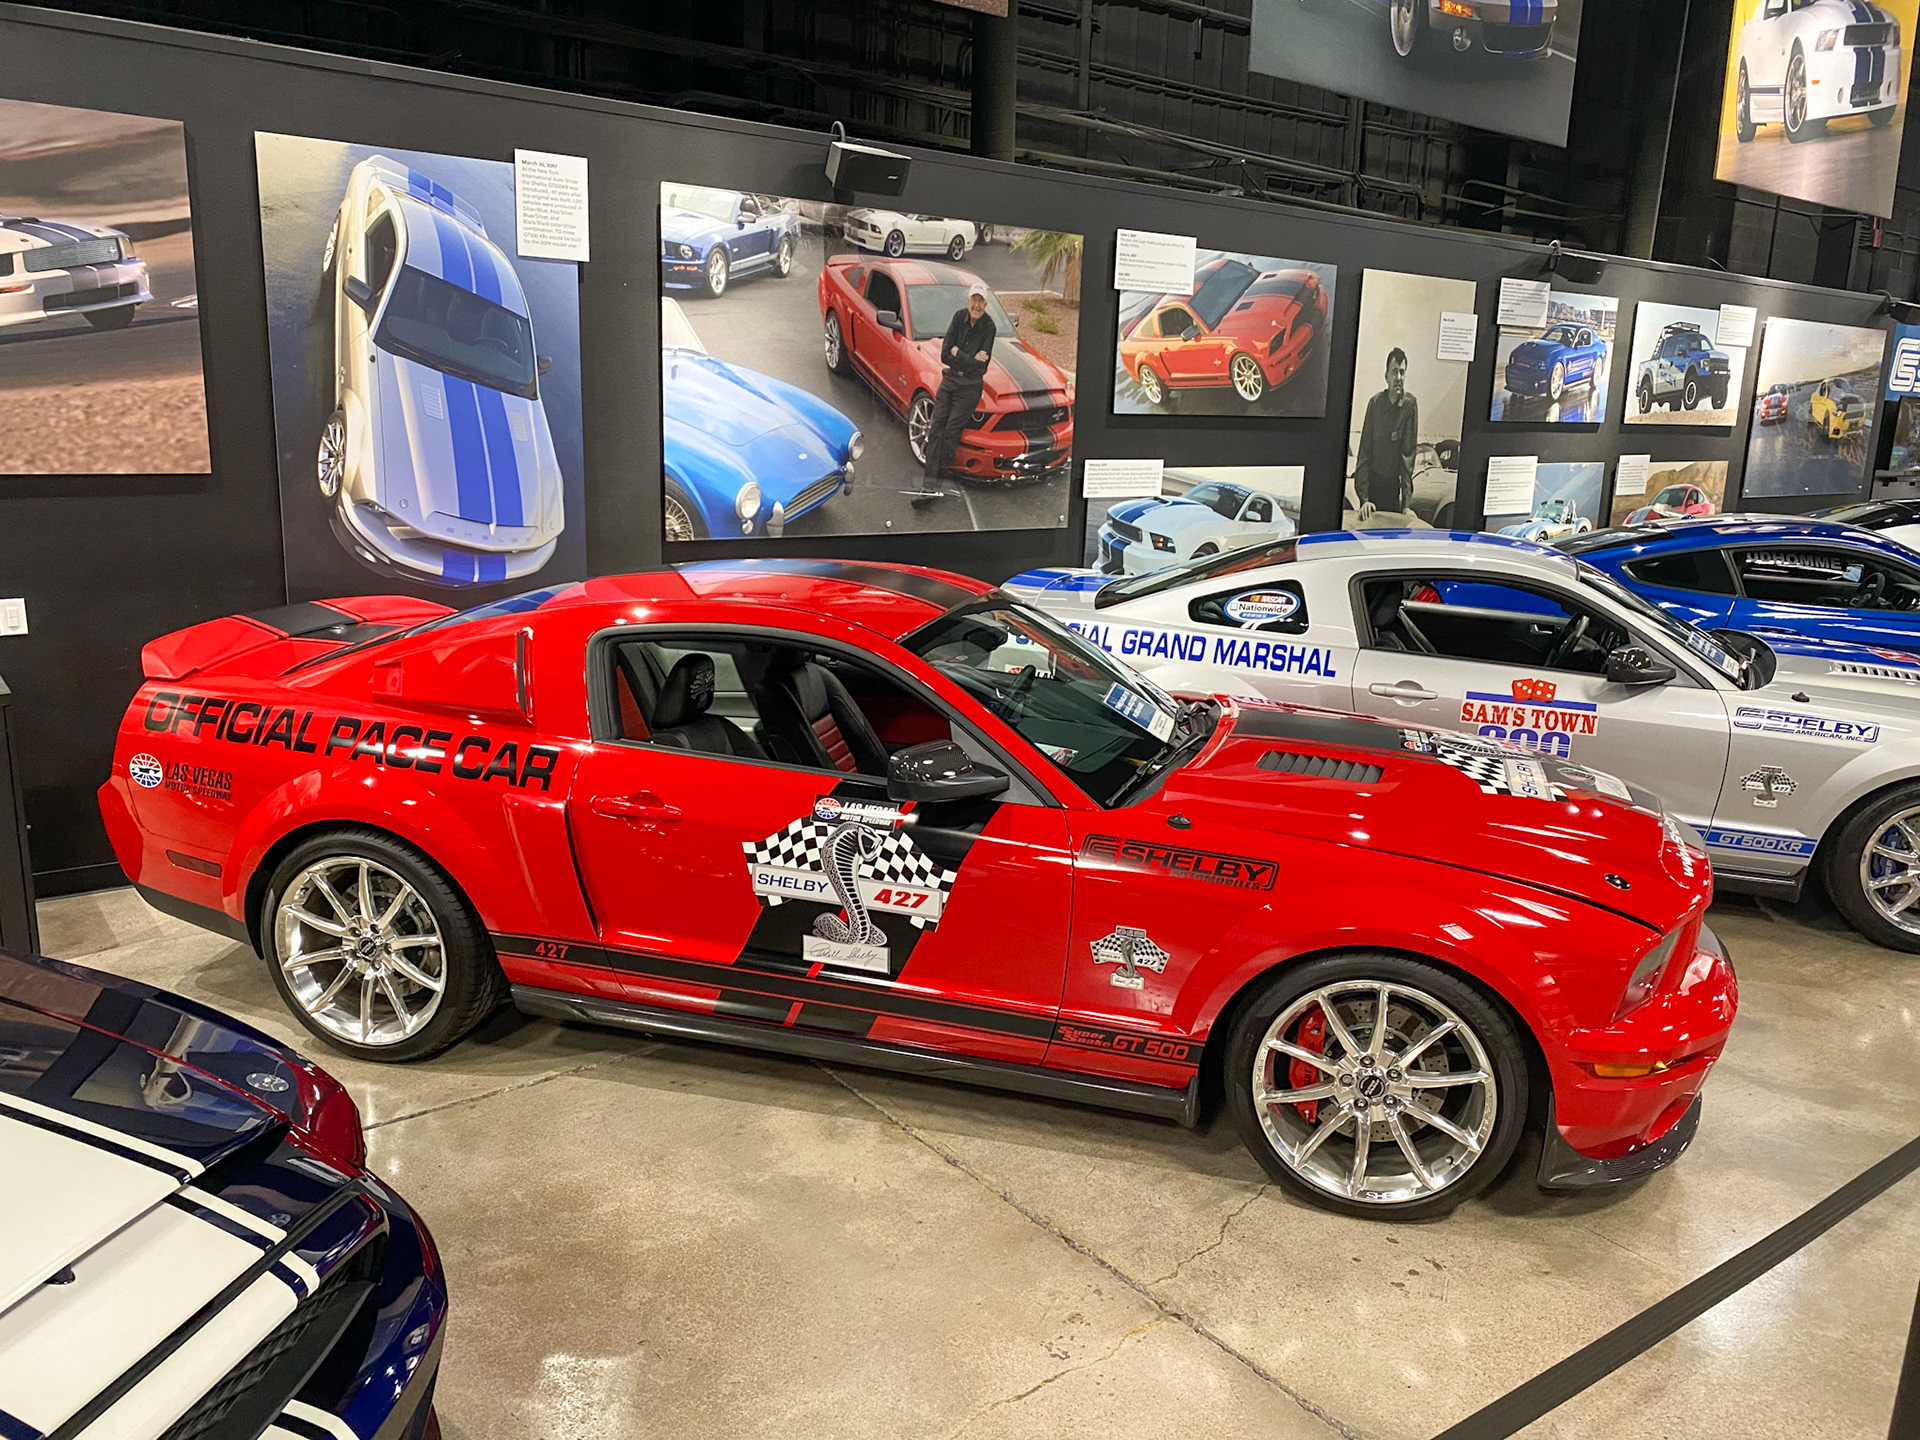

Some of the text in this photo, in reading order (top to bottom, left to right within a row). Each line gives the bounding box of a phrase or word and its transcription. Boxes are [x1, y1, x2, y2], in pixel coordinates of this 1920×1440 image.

[531, 180, 547, 188] Shelby
[1238, 603, 1288, 613] Nationwide
[1260, 595, 1288, 604] NASCAR
[1121, 629, 1208, 663] GRAND
[1213, 637, 1337, 677] MARSHAL
[1461, 701, 1598, 735] SAM'S TOWN
[143, 691, 562, 791] OFFICIAL PACE CAR
[1793, 729, 1863, 743] AMERICAN, INC.
[164, 761, 234, 791] LAS VEGAS
[164, 781, 233, 801] MOTOR SPEEDWAY
[1119, 845, 1271, 882] SHELBY
[1169, 869, 1261, 890] AUTOMOBILES
[757, 873, 930, 909] SHELBY 427
[535, 942, 569, 959] 427
[1058, 1025, 1106, 1040] Super
[1062, 1034, 1112, 1048] Snake
